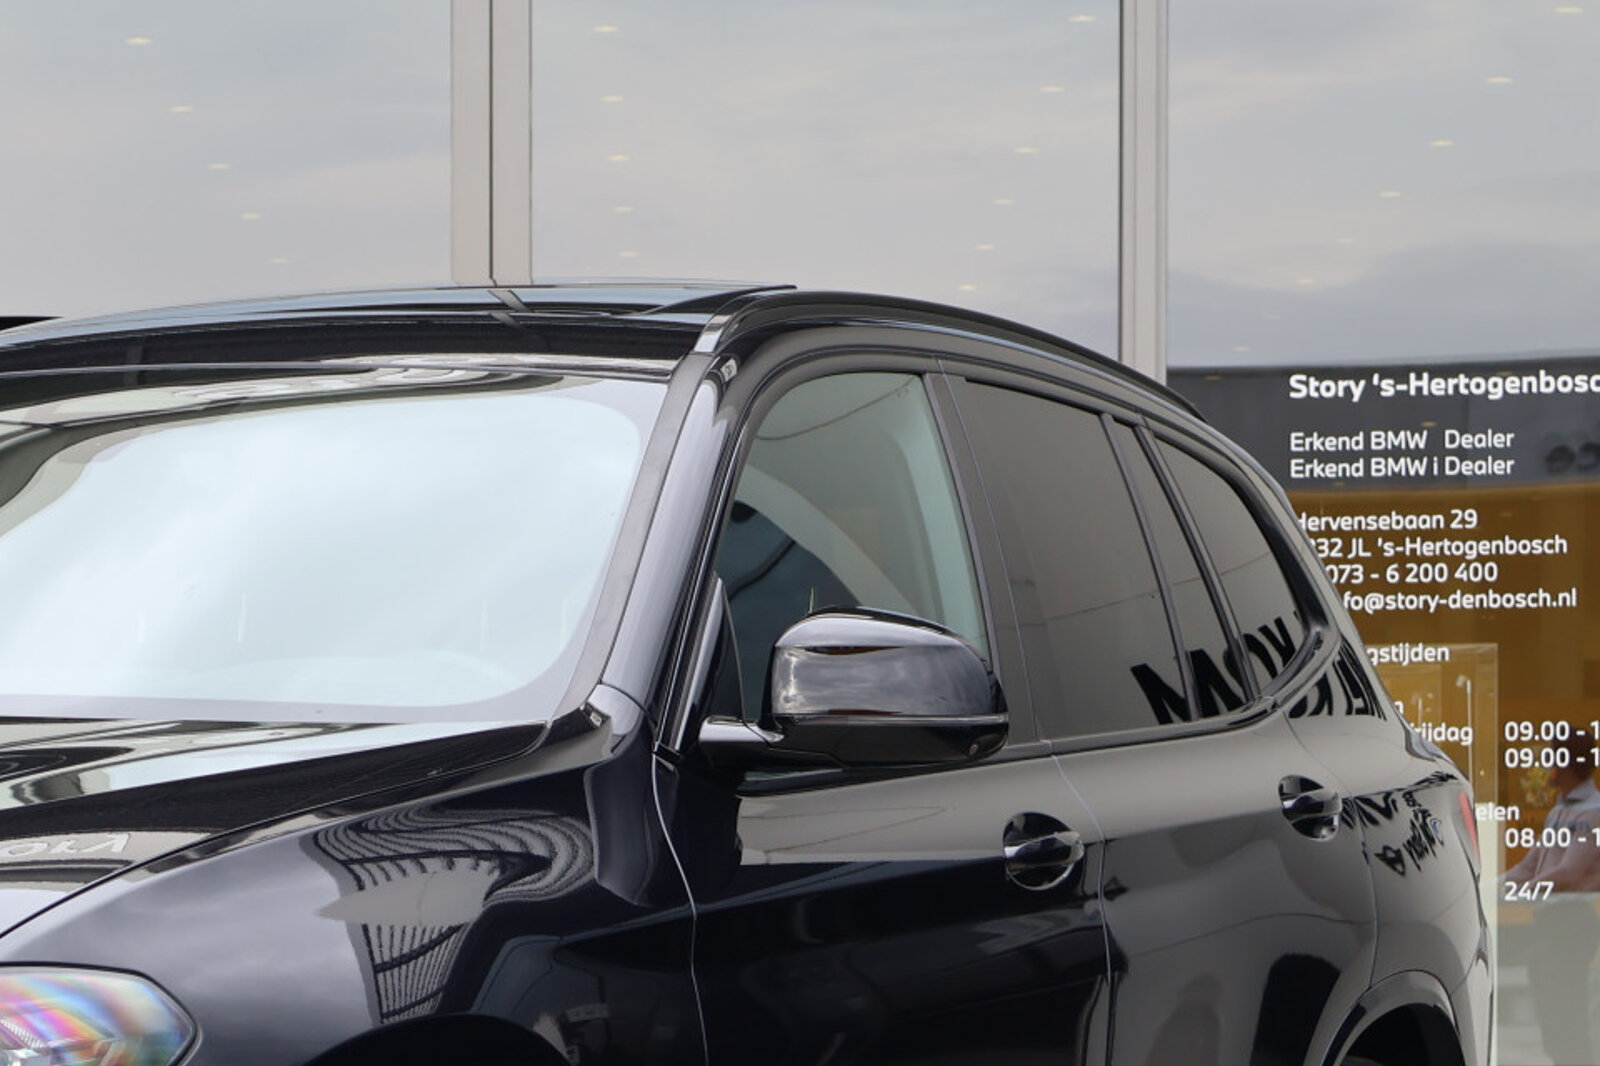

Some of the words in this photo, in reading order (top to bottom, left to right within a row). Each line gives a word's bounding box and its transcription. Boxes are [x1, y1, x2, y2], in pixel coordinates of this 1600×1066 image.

[1289, 374, 1366, 402] Story
[1372, 369, 1600, 400] 's-Hertogenbosc
[1290, 431, 1364, 452] Erkend
[1370, 429, 1428, 451] BMW
[1444, 428, 1515, 449] Dealer
[1290, 457, 1364, 478] Erkend
[1370, 456, 1428, 477] BMW
[1432, 456, 1439, 476] i
[1444, 455, 1515, 476] Dealer
[1450, 508, 1478, 529] 29
[1310, 537, 1343, 558] 32
[1347, 537, 1372, 559] JL
[1377, 534, 1568, 560] 's-Hertogenbosch
[1325, 564, 1364, 584] 073
[1386, 563, 1400, 583] 6
[1405, 562, 1448, 583] 200
[1454, 562, 1498, 582] 400
[1343, 587, 1577, 615] fo@story-denbosch.nl
[1366, 643, 1450, 666] gstijden
[1505, 721, 1570, 741] 09.00
[1505, 748, 1570, 768] 09.00
[1505, 828, 1571, 848] 08.00
[1504, 881, 1554, 901] 24/7
